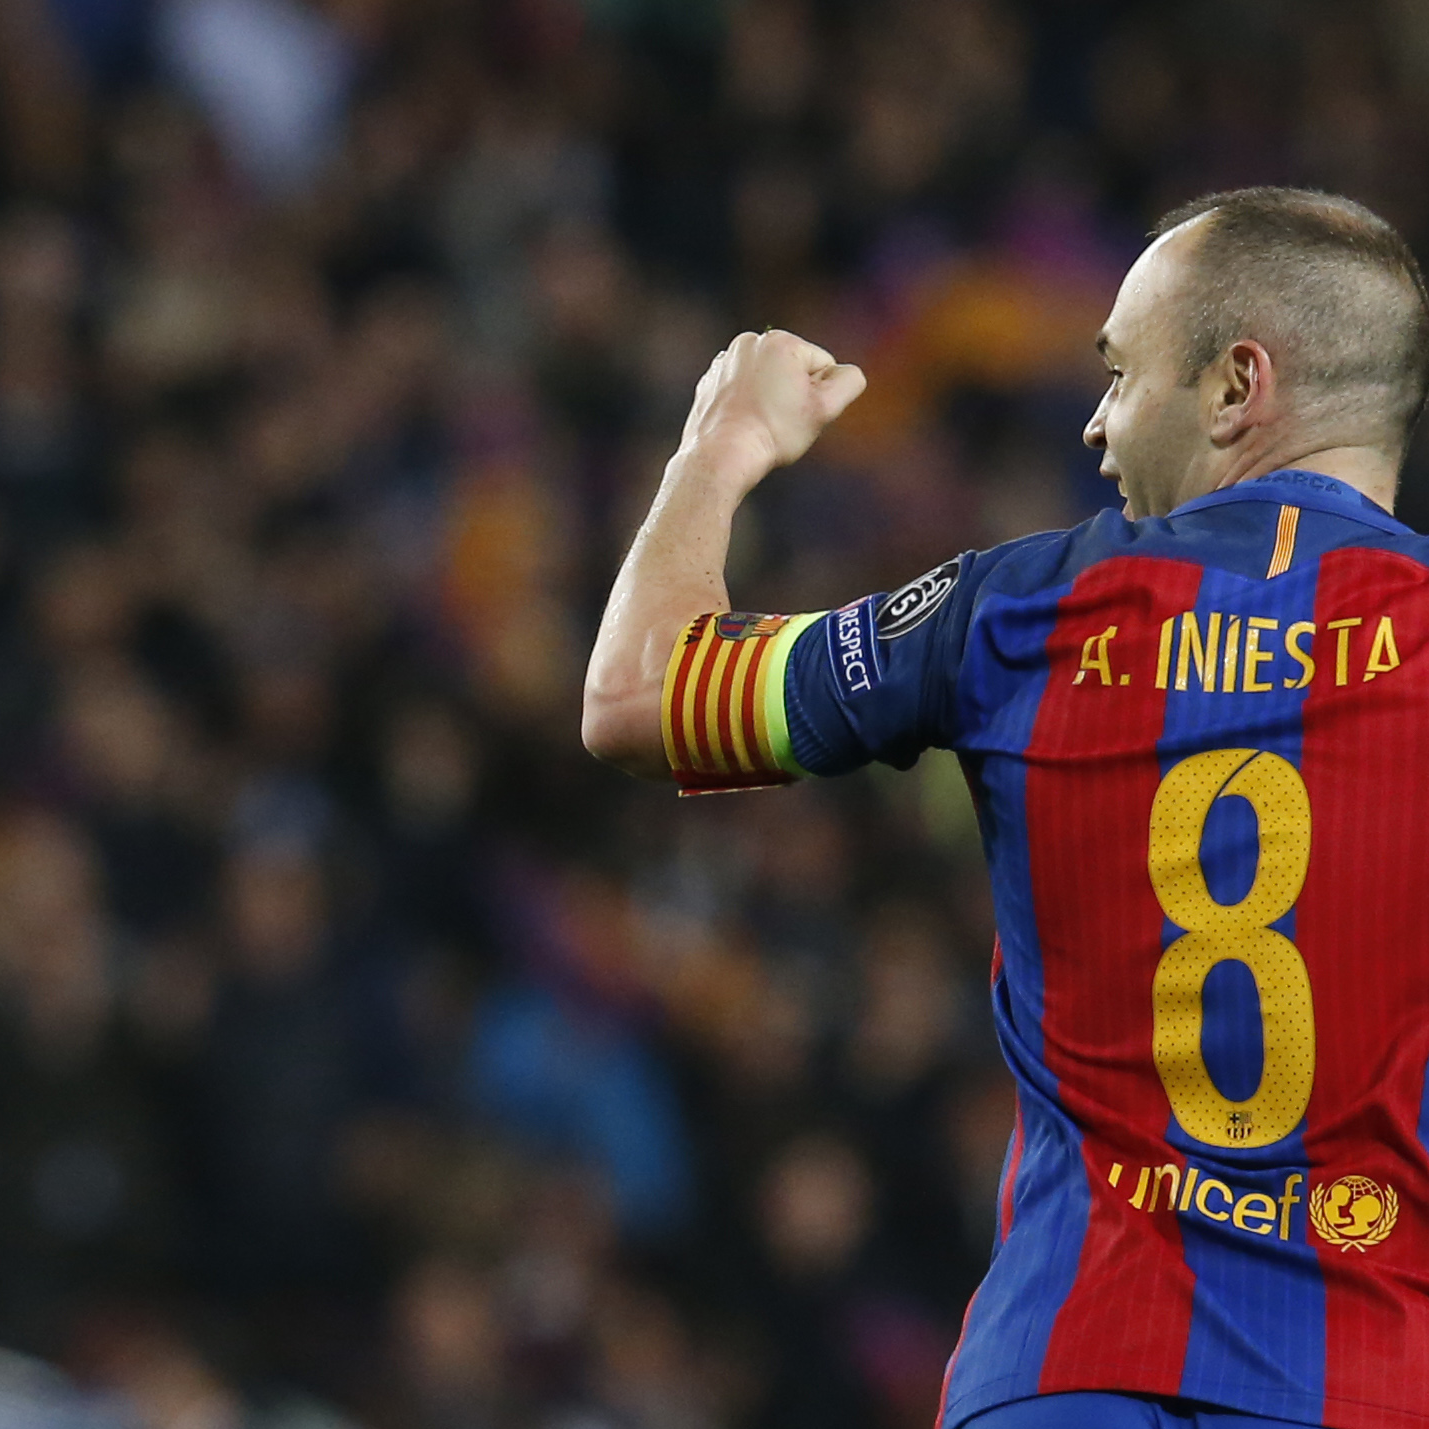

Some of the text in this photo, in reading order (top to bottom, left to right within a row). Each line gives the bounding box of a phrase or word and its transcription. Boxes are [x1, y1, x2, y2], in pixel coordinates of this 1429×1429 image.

[890, 592, 918, 617] 5
[838, 607, 872, 692] RESPECT
[1071, 611, 1401, 693] A. INIESTA
[1147, 747, 1317, 1149] 8
[1107, 1162, 1303, 1241] unicef
